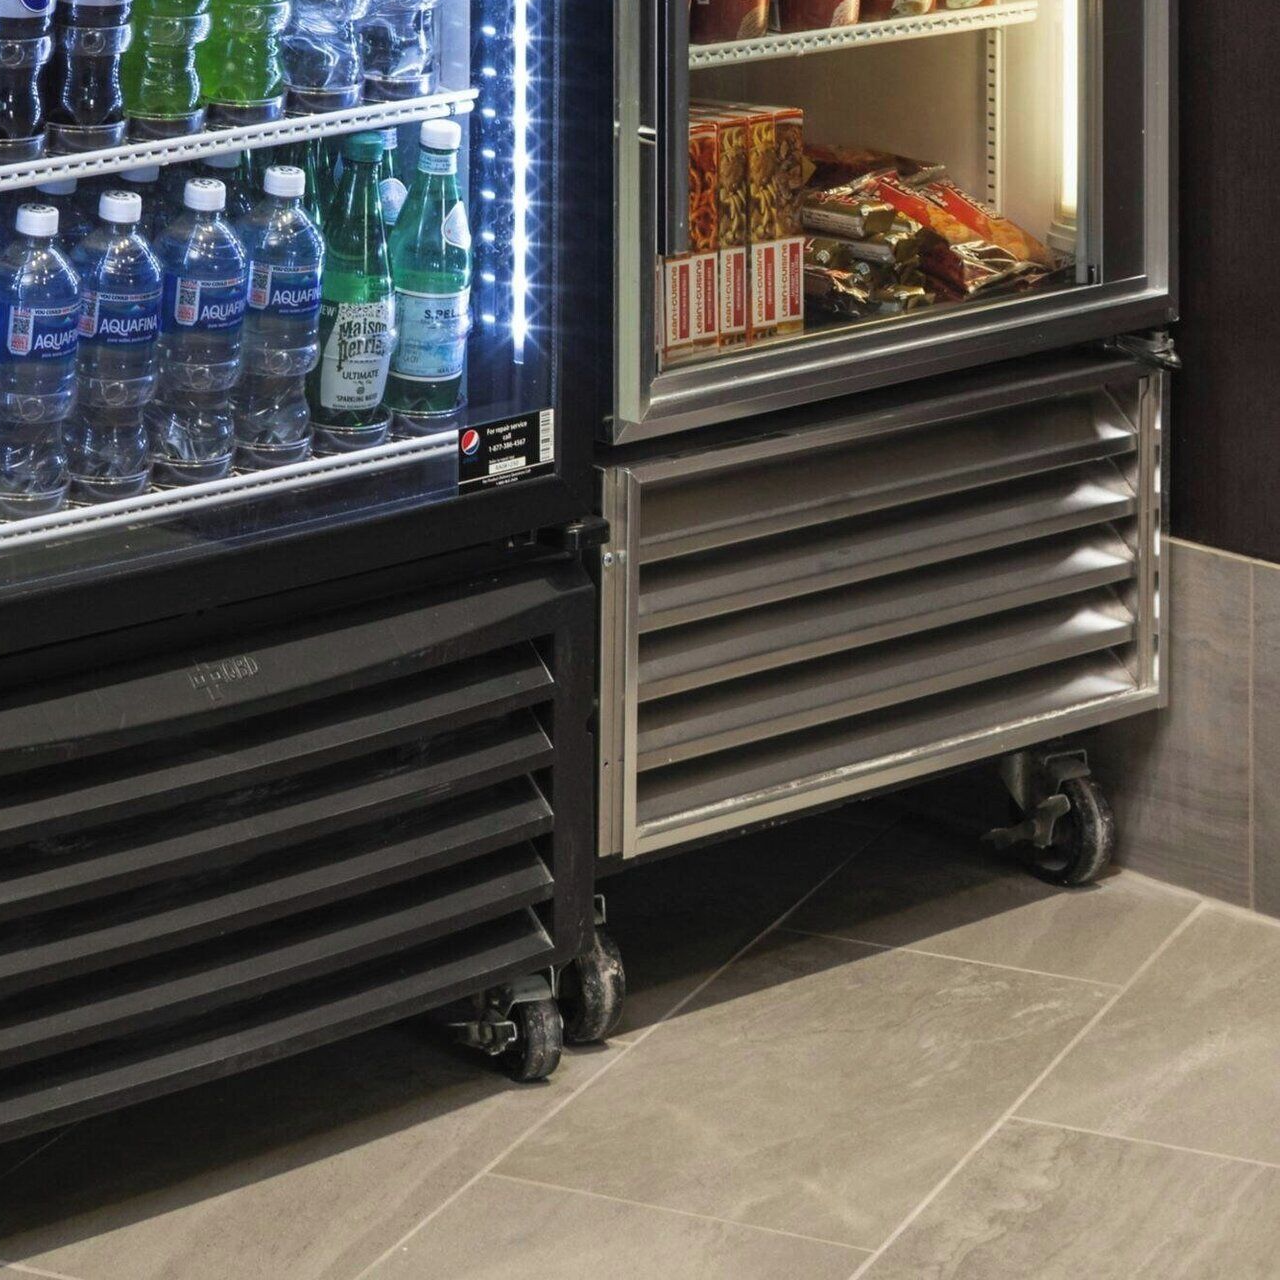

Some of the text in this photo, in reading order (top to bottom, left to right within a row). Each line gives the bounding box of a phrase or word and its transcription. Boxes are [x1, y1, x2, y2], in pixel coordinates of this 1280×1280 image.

[99, 315, 158, 336] AQUAFINA
[338, 317, 388, 341] Maison
[342, 368, 380, 380] ULTIMATE
[336, 393, 364, 403] SPARKLING
[495, 425, 511, 435] repair
[510, 421, 528, 430] service
[502, 432, 512, 441] call
